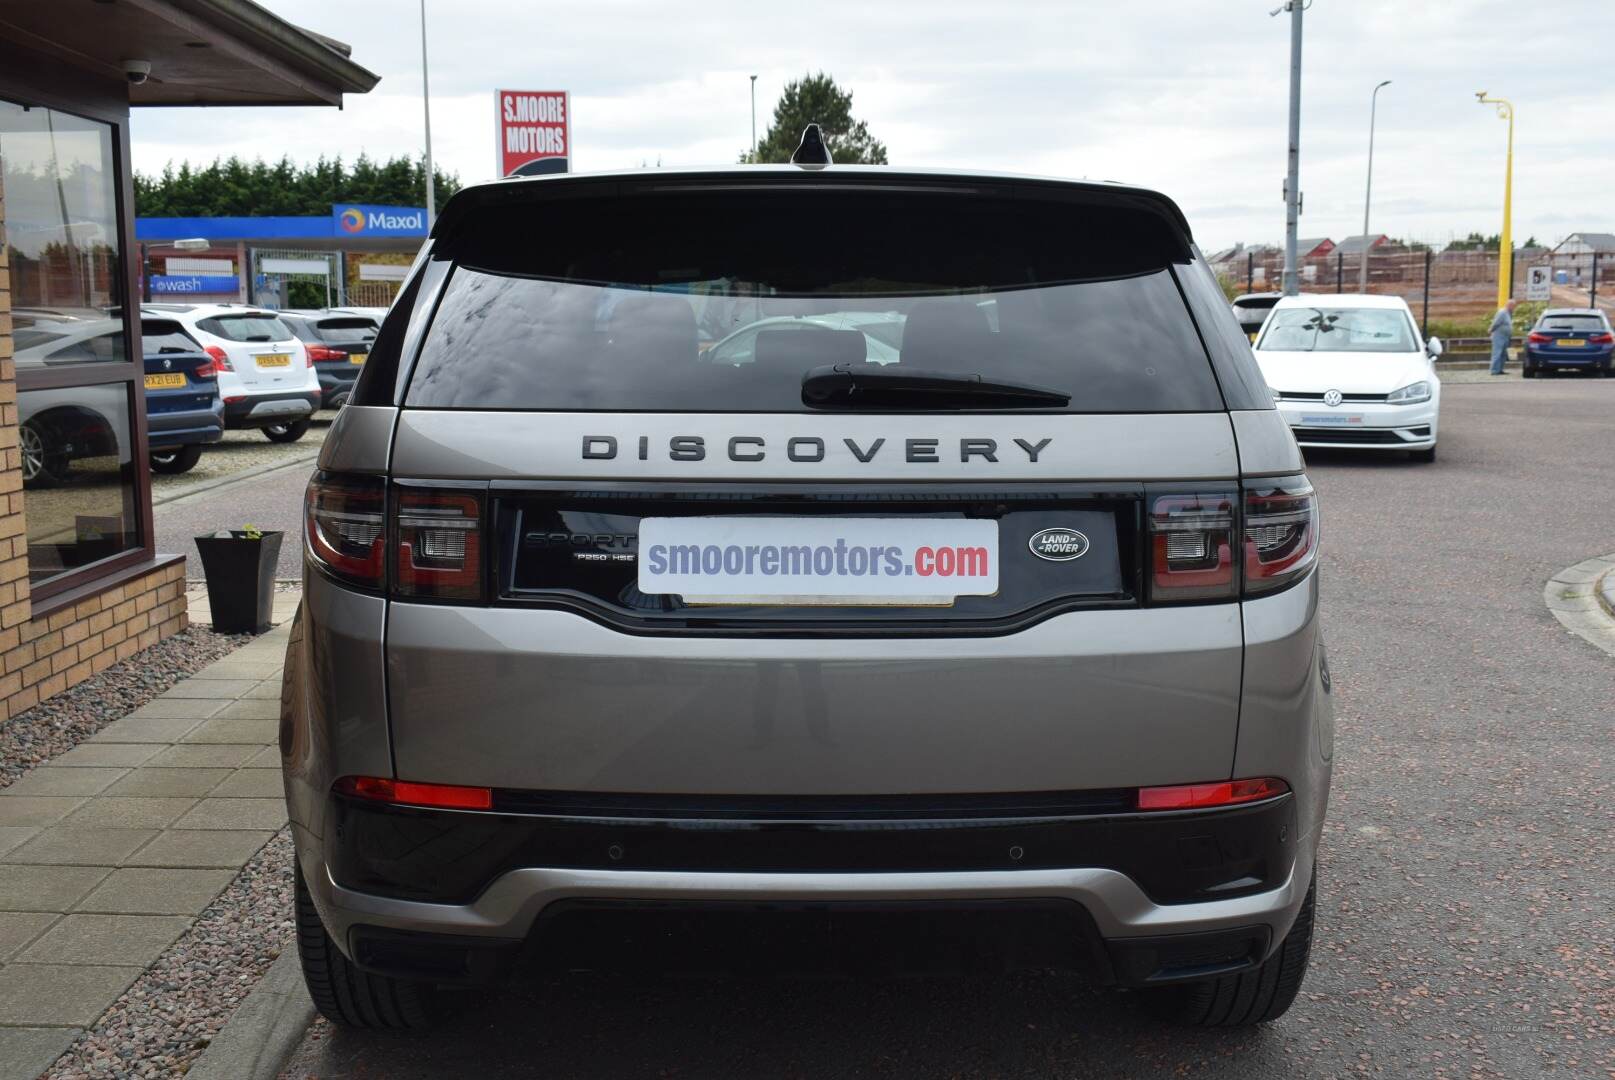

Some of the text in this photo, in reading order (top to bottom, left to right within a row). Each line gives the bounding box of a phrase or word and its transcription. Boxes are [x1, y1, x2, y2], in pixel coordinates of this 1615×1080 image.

[504, 95, 564, 123] S.MOORE
[506, 126, 564, 153] MOTORS
[368, 212, 422, 230] Maxol
[581, 434, 1054, 464] DISCOVERY
[525, 532, 637, 549] SPORT
[1041, 534, 1070, 544] LAND
[1044, 543, 1079, 553] ROVER
[611, 553, 636, 561] HSE
[648, 538, 988, 577] smooremotors.com
